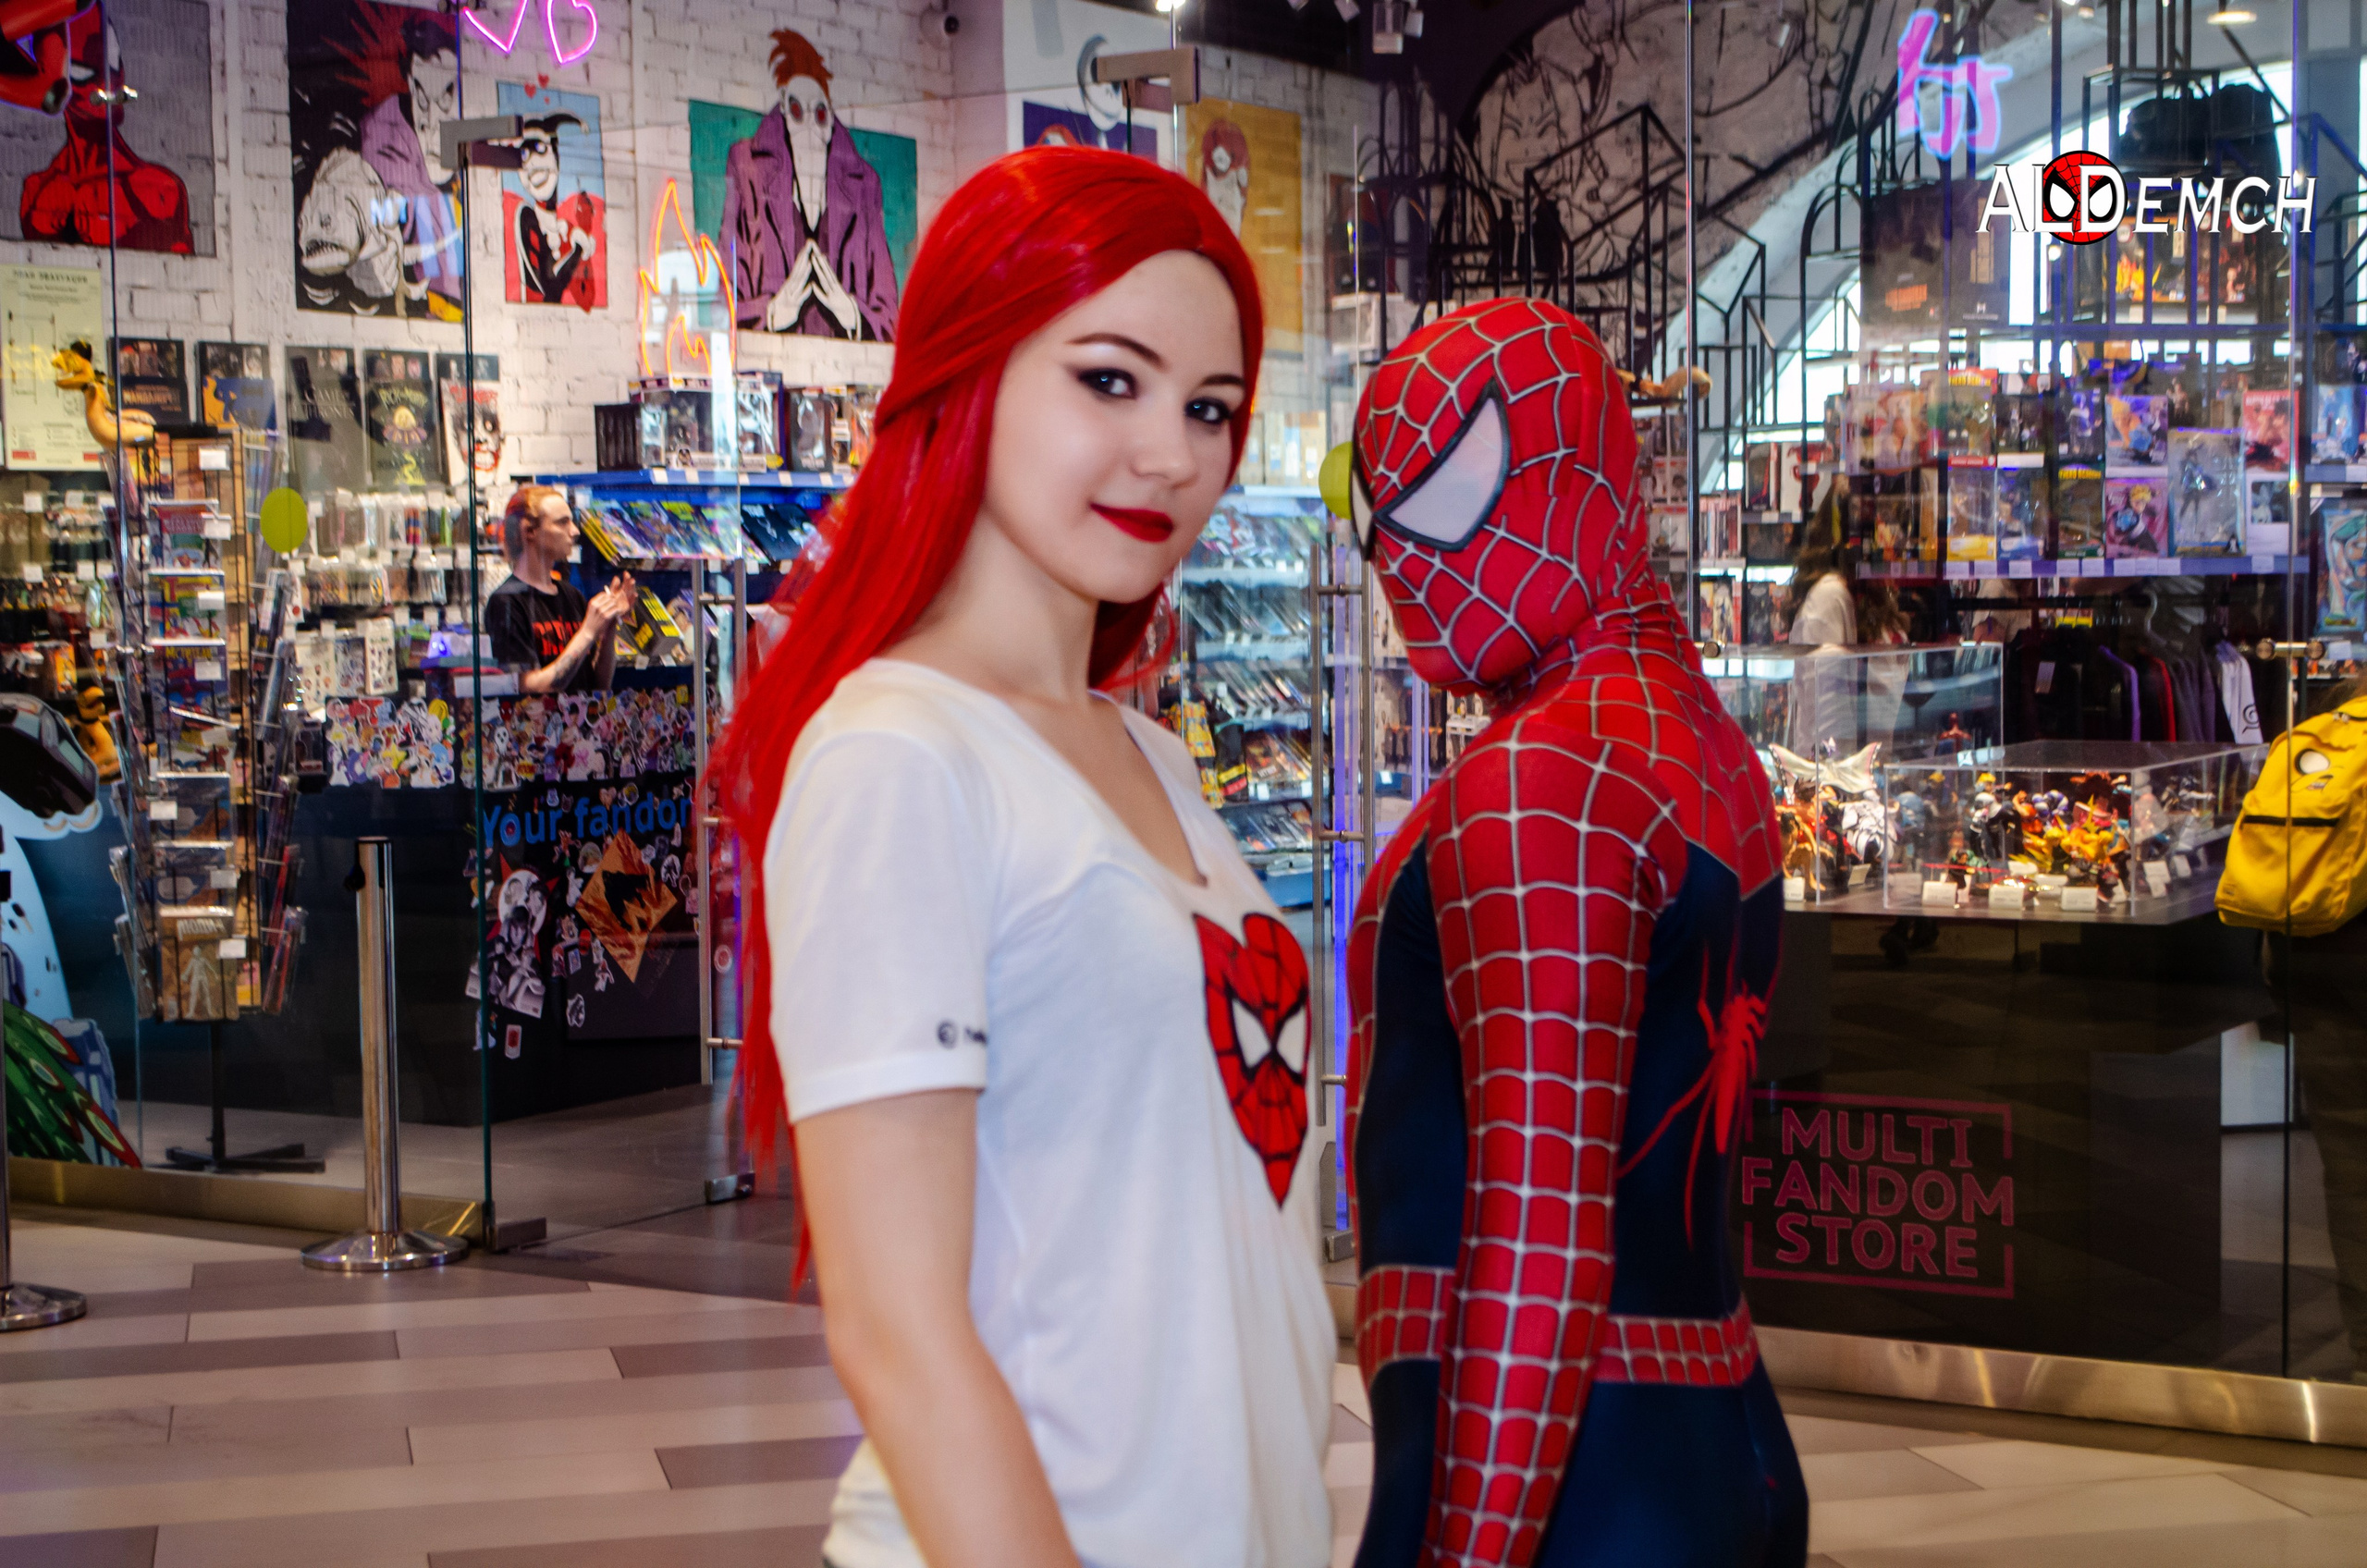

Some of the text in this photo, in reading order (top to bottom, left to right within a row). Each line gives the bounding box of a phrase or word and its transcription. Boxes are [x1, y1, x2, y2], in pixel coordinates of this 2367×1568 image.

[483, 804, 563, 848] Your
[1781, 1108, 1973, 1168] MULTI
[1742, 1158, 2014, 1226] FANDOM
[1776, 1213, 1978, 1278] STORE
